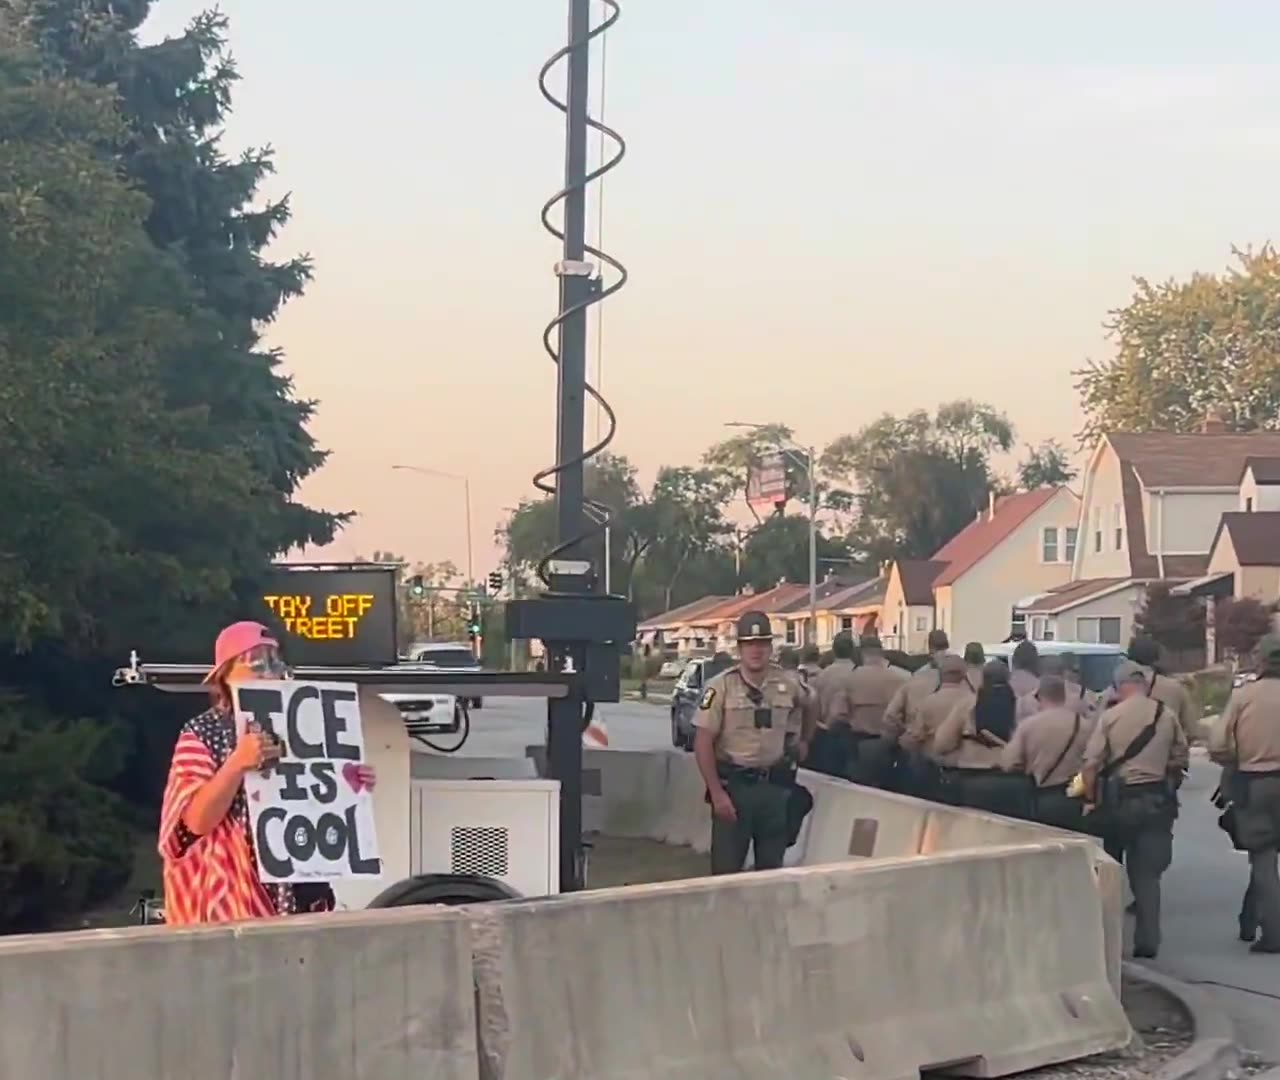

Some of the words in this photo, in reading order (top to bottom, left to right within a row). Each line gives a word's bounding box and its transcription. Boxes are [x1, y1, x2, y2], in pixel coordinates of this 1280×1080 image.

[263, 595, 312, 617] TAY
[326, 594, 374, 616] OFF
[284, 616, 358, 639] TREET
[238, 685, 361, 760] ICE
[276, 762, 337, 803] IS
[256, 803, 381, 878] COOL
